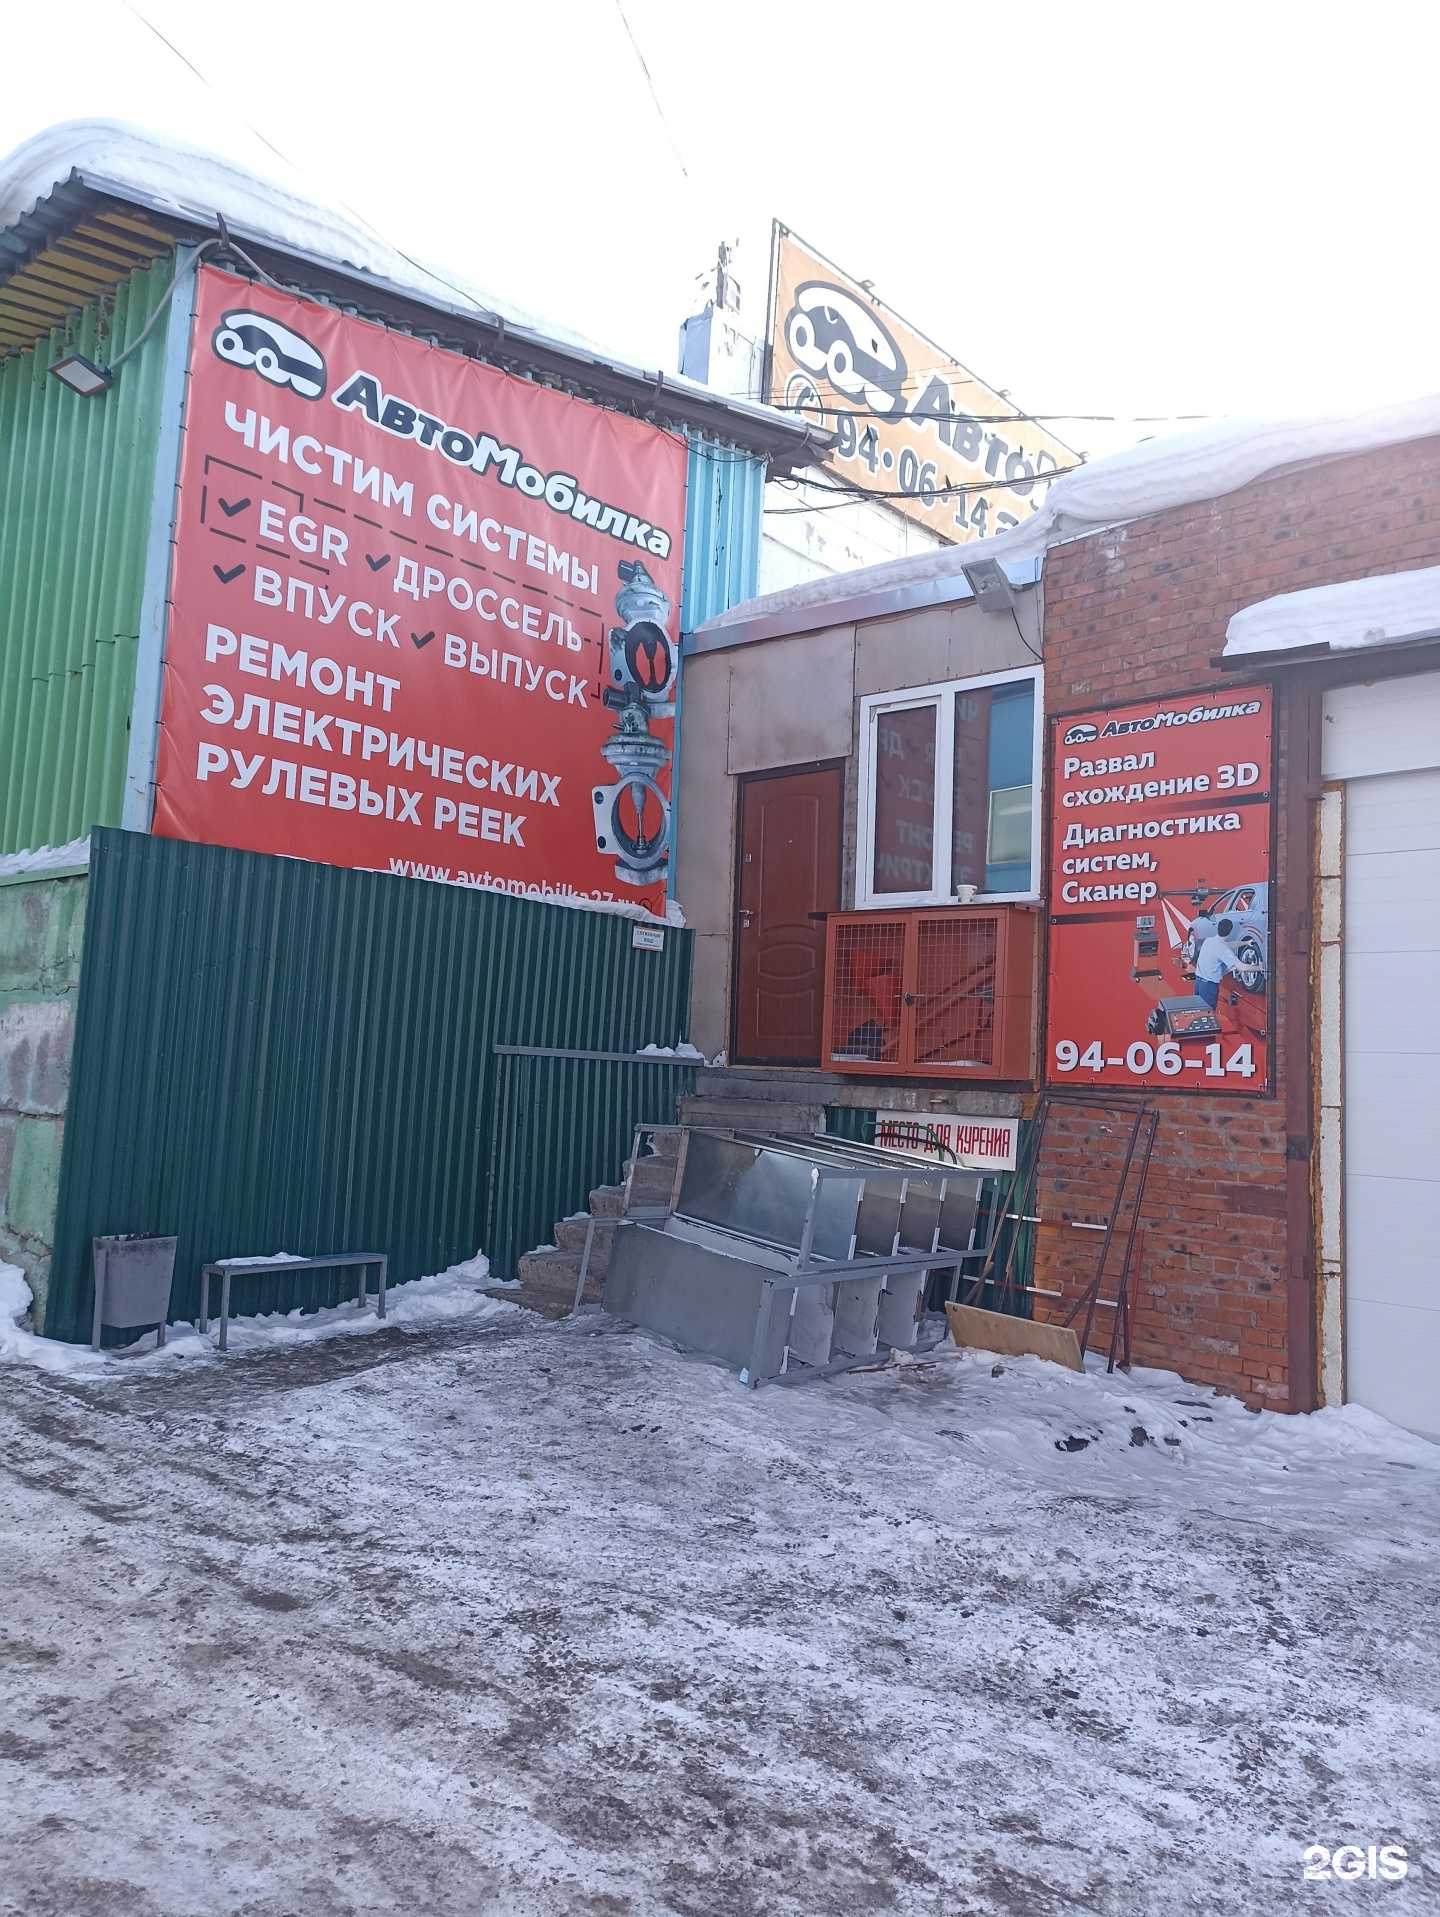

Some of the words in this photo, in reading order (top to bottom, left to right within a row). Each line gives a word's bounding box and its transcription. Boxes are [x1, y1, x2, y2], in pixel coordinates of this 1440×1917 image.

[331, 369, 672, 559] АвтоМобилка
[225, 401, 415, 517] ЧИСТИМ
[426, 493, 600, 595] СИСТЕМЫ
[259, 500, 349, 566] EGR
[253, 566, 401, 648] ВПУСК
[393, 556, 583, 652] ДРОССЕЛЬ
[205, 623, 401, 712] РЕМОНТ
[443, 633, 589, 709] ВЫПУСК
[200, 684, 562, 807] ЭЛЕКТРИЧЕСКИХ
[1100, 701, 1261, 738] АвтоМобилка
[196, 741, 422, 827] РУЛЕВЫХ
[433, 797, 527, 848] РЕЕК
[1062, 773, 1210, 808] схождение
[1216, 762, 1260, 789] 3D
[1064, 751, 1155, 779] Развал
[1062, 812, 1241, 850] Диагностика
[1062, 852, 1158, 875] систем,
[1062, 880, 1158, 904] Сканер
[1054, 1040, 1258, 1078] 94-06-14
[880, 1119, 919, 1149] МЕСТО
[956, 1125, 1011, 1158] КУРЕНИЯ
